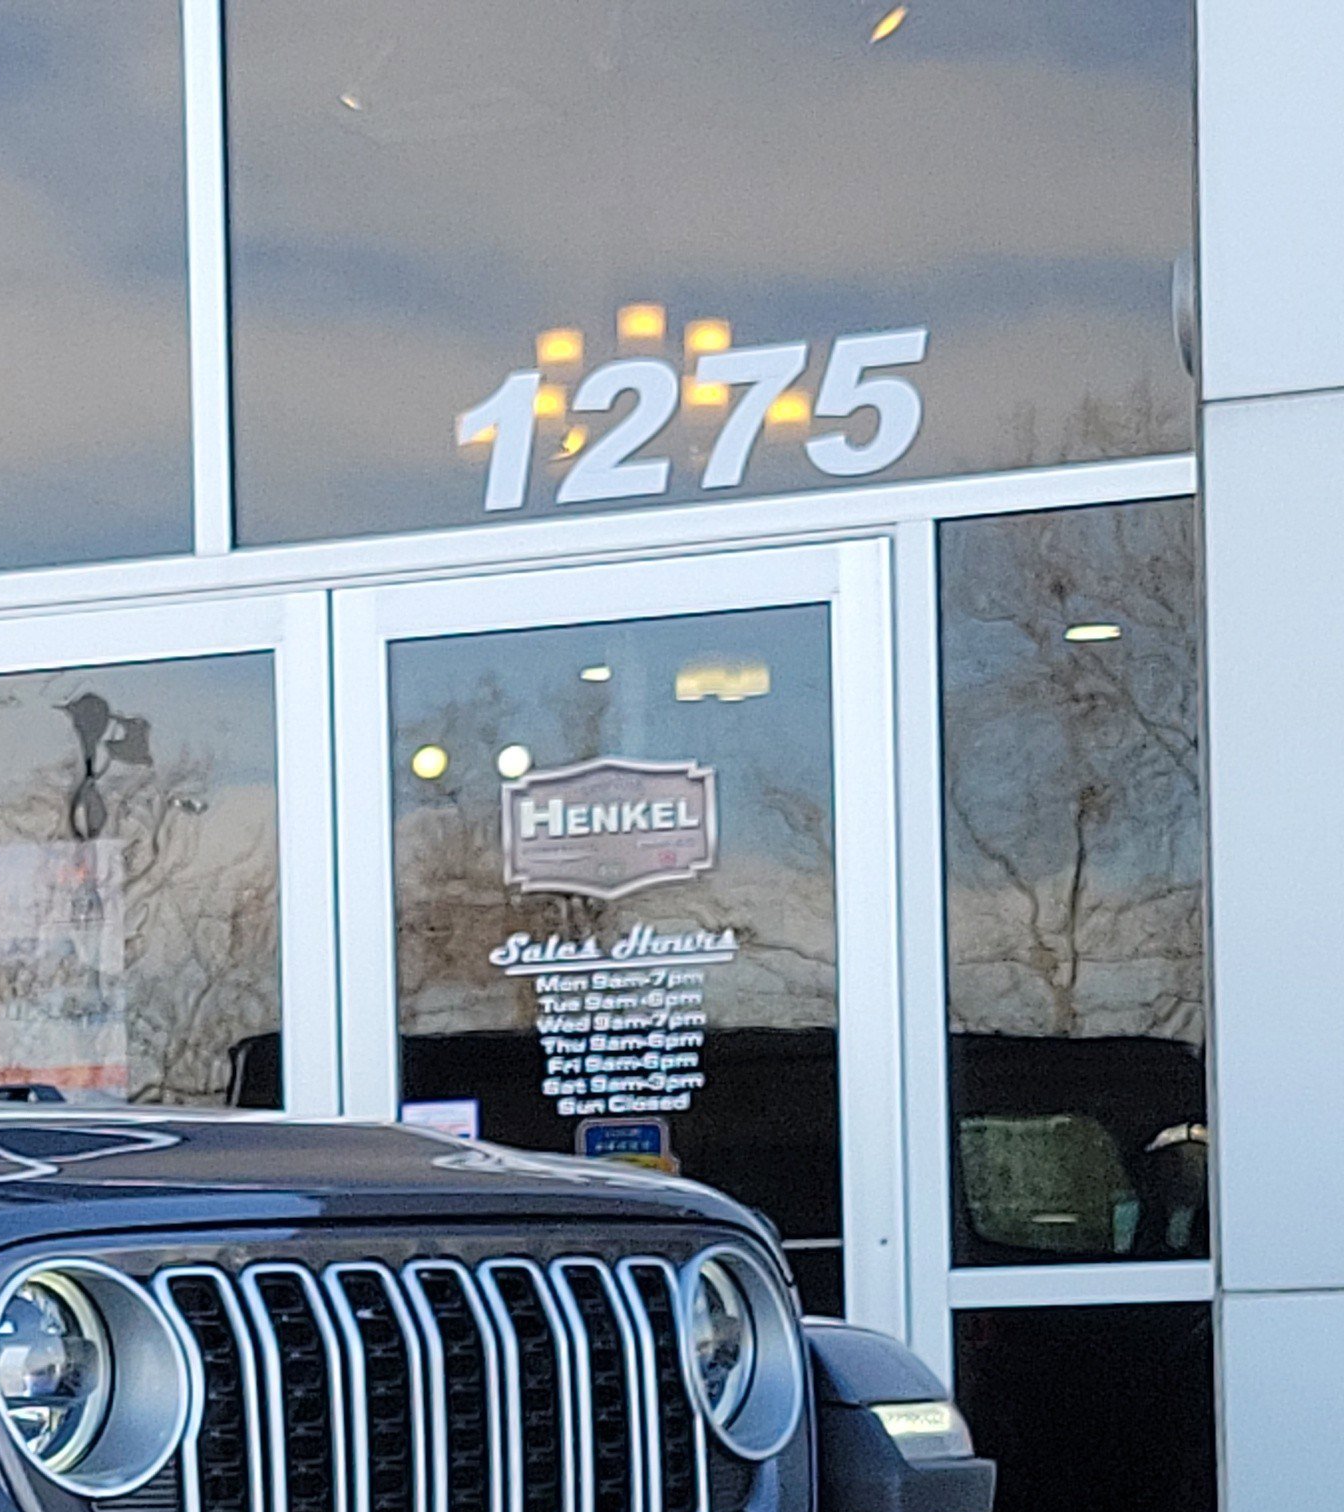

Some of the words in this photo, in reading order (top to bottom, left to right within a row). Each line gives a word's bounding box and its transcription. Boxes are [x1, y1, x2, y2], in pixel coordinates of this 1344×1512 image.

[455, 327, 928, 513] 1275
[519, 797, 700, 841] HENKEL
[489, 931, 603, 965] Sales
[611, 924, 740, 960] Hours
[535, 974, 589, 993] Mon
[591, 968, 704, 990] 9am-7pm
[537, 994, 582, 1013] Tue
[536, 1012, 591, 1034] Wed
[593, 1009, 707, 1031] 9am-7pm
[539, 1036, 587, 1055] Thu
[547, 1056, 582, 1074] Fri
[542, 1077, 587, 1095] Sat
[557, 1096, 606, 1116] Sun
[608, 1091, 692, 1113] Closed
